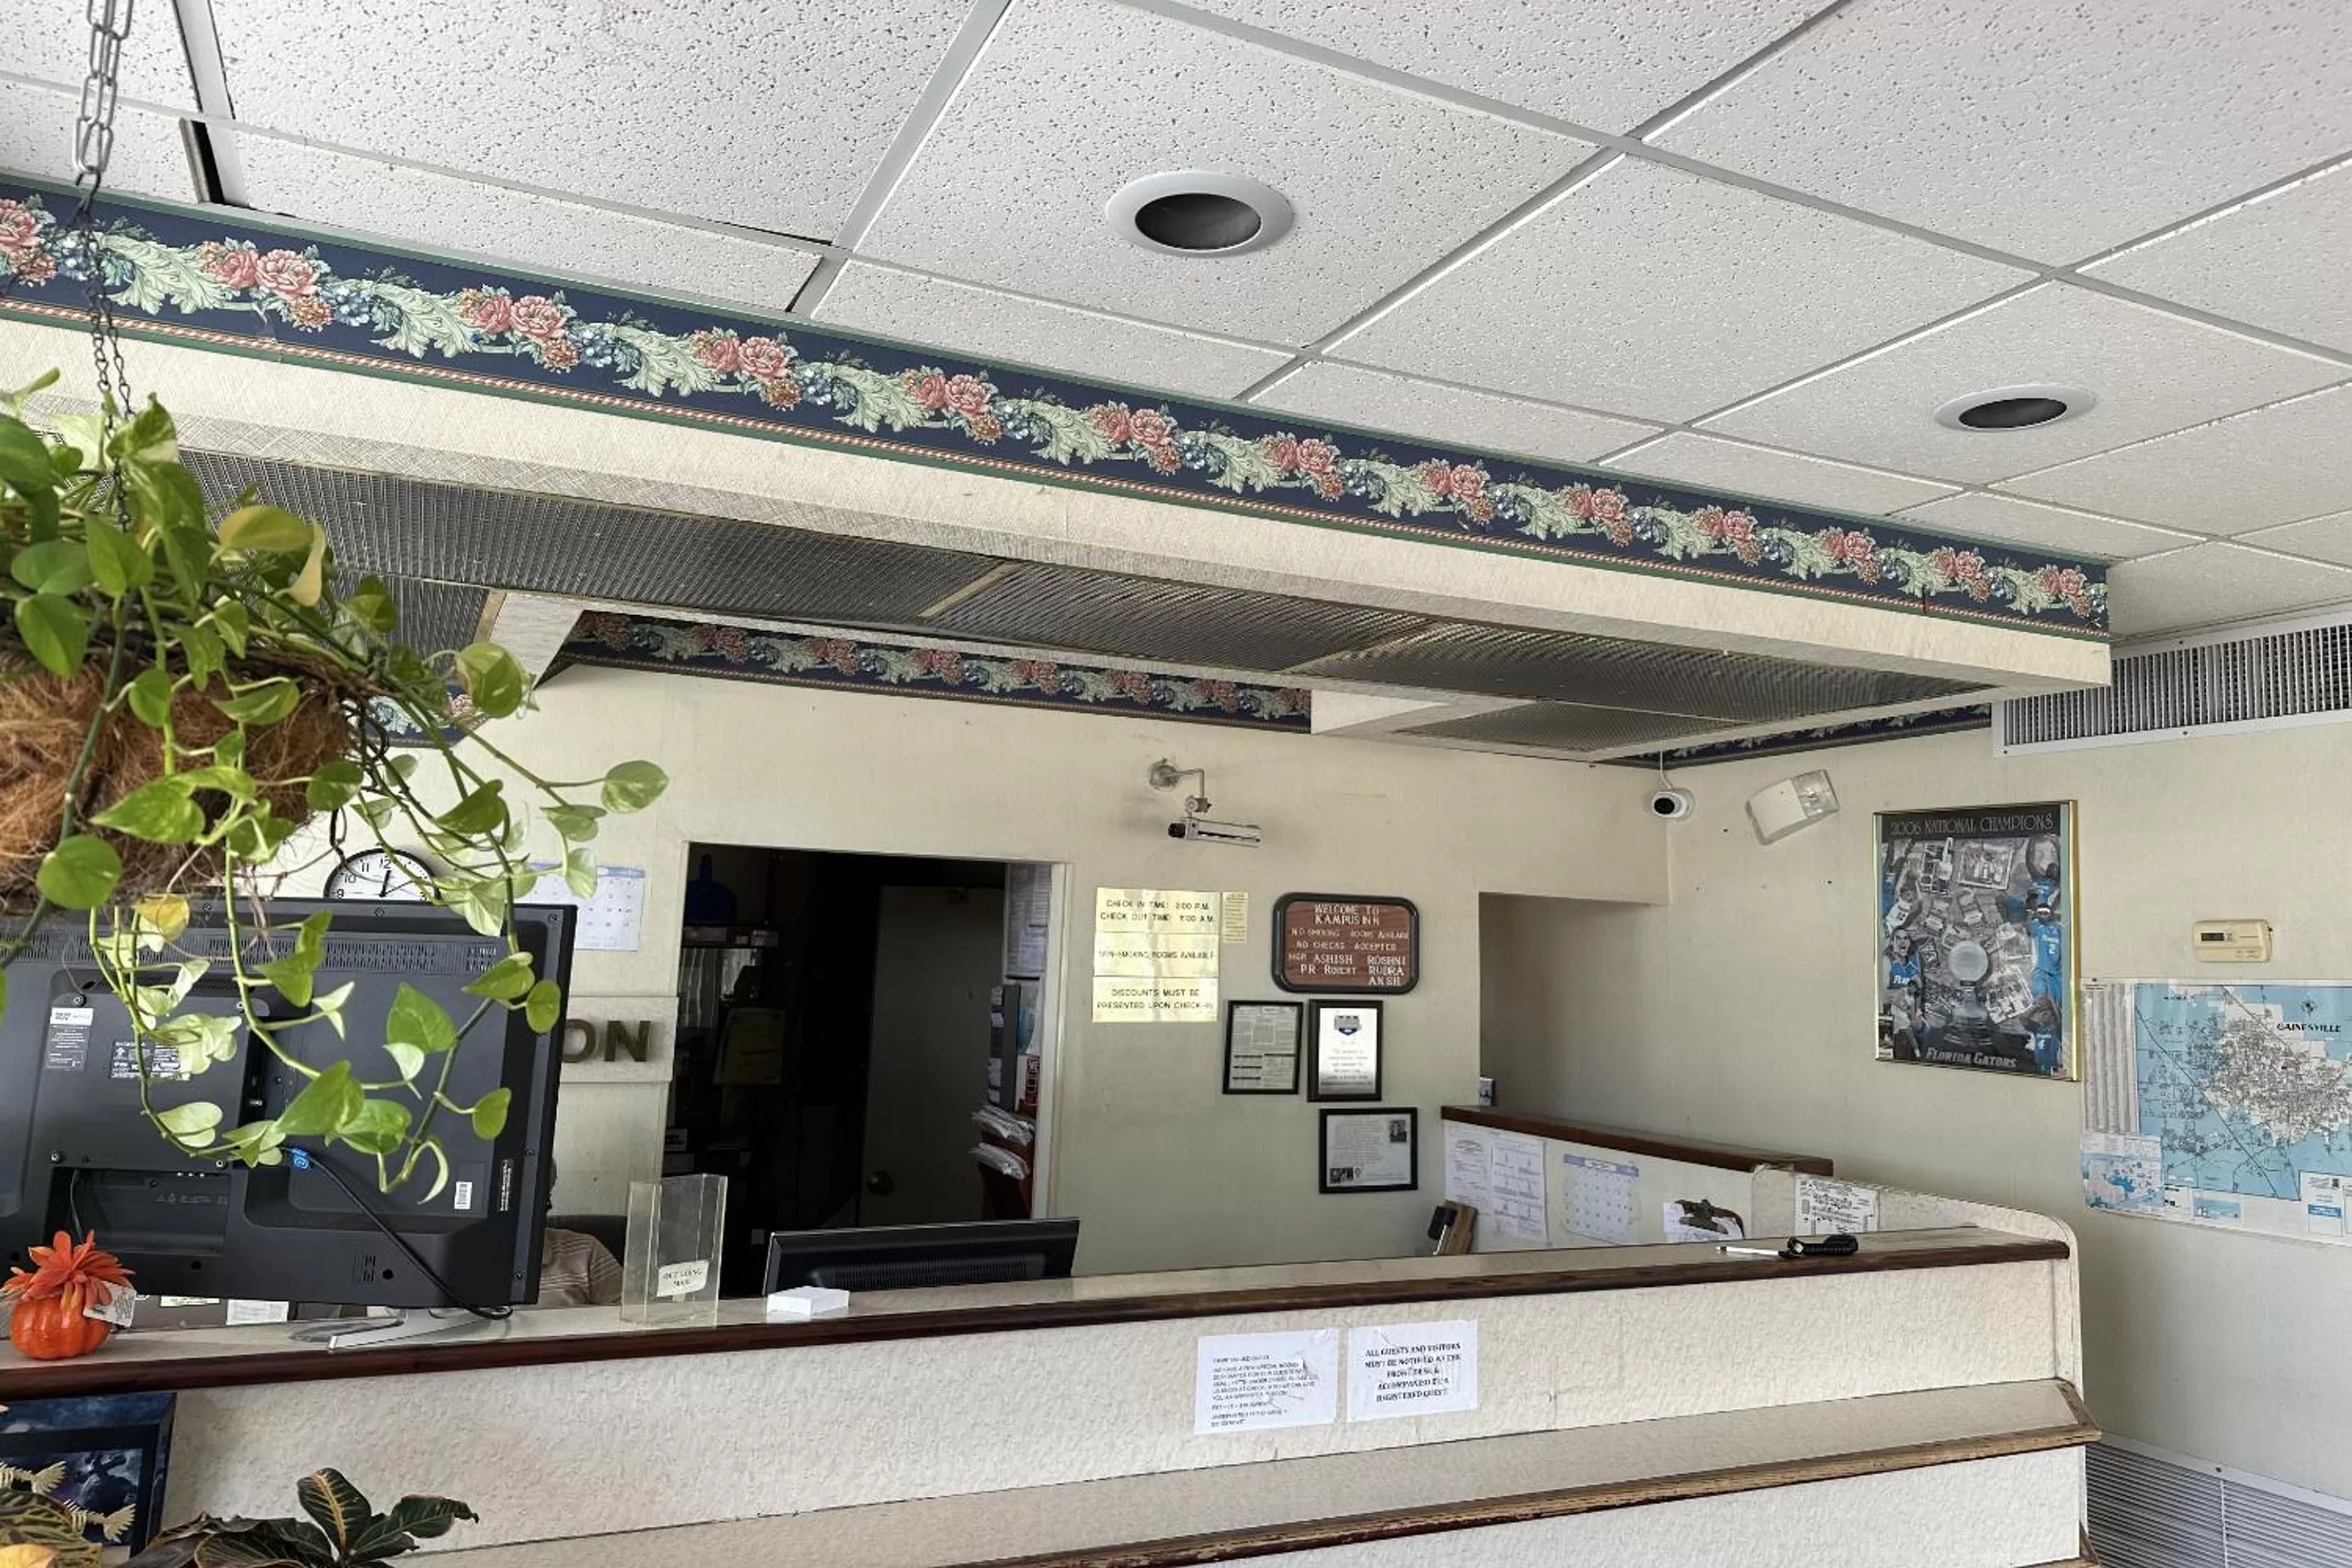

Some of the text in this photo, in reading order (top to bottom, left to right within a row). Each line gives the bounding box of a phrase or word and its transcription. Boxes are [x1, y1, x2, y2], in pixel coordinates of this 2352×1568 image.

[1891, 813, 2053, 835] 2006 NATIONAL CHAMPIONS
[362, 863, 369, 872] 11
[380, 858, 391, 869] 12
[345, 874, 357, 884] 10
[336, 889, 344, 898] 9
[1106, 899, 1133, 908] CHECK
[1315, 904, 1379, 915] WELCOME TO
[1100, 911, 1126, 921] CHECK
[1315, 915, 1379, 925] KAMPUS INN
[1350, 929, 1374, 938] ROOMS
[1296, 941, 1397, 951] NO CHECKS ACCEPTED
[1152, 951, 1178, 960] ROOMS
[1180, 951, 1214, 960] AVAILABLE
[1313, 953, 1352, 964] ASHISH
[1367, 955, 1405, 965] ROSHNI
[1368, 965, 1404, 976] RUDRA
[1111, 988, 1160, 997] DISCOUNTS
[1163, 989, 1185, 997] MUST
[1097, 1000, 1214, 1010] PRESENTED UPON CHECK-IN
[2276, 1022, 2342, 1033] GAINESVILLE
[1926, 1047, 2018, 1068] FLORIDA GATORS
[1365, 1343, 1461, 1357] ALL GUESTS AND VISITORS
[1365, 1360, 1385, 1368] MUST
[1399, 1356, 1435, 1365] NOTIFIED
[1446, 1353, 1462, 1361] THE
